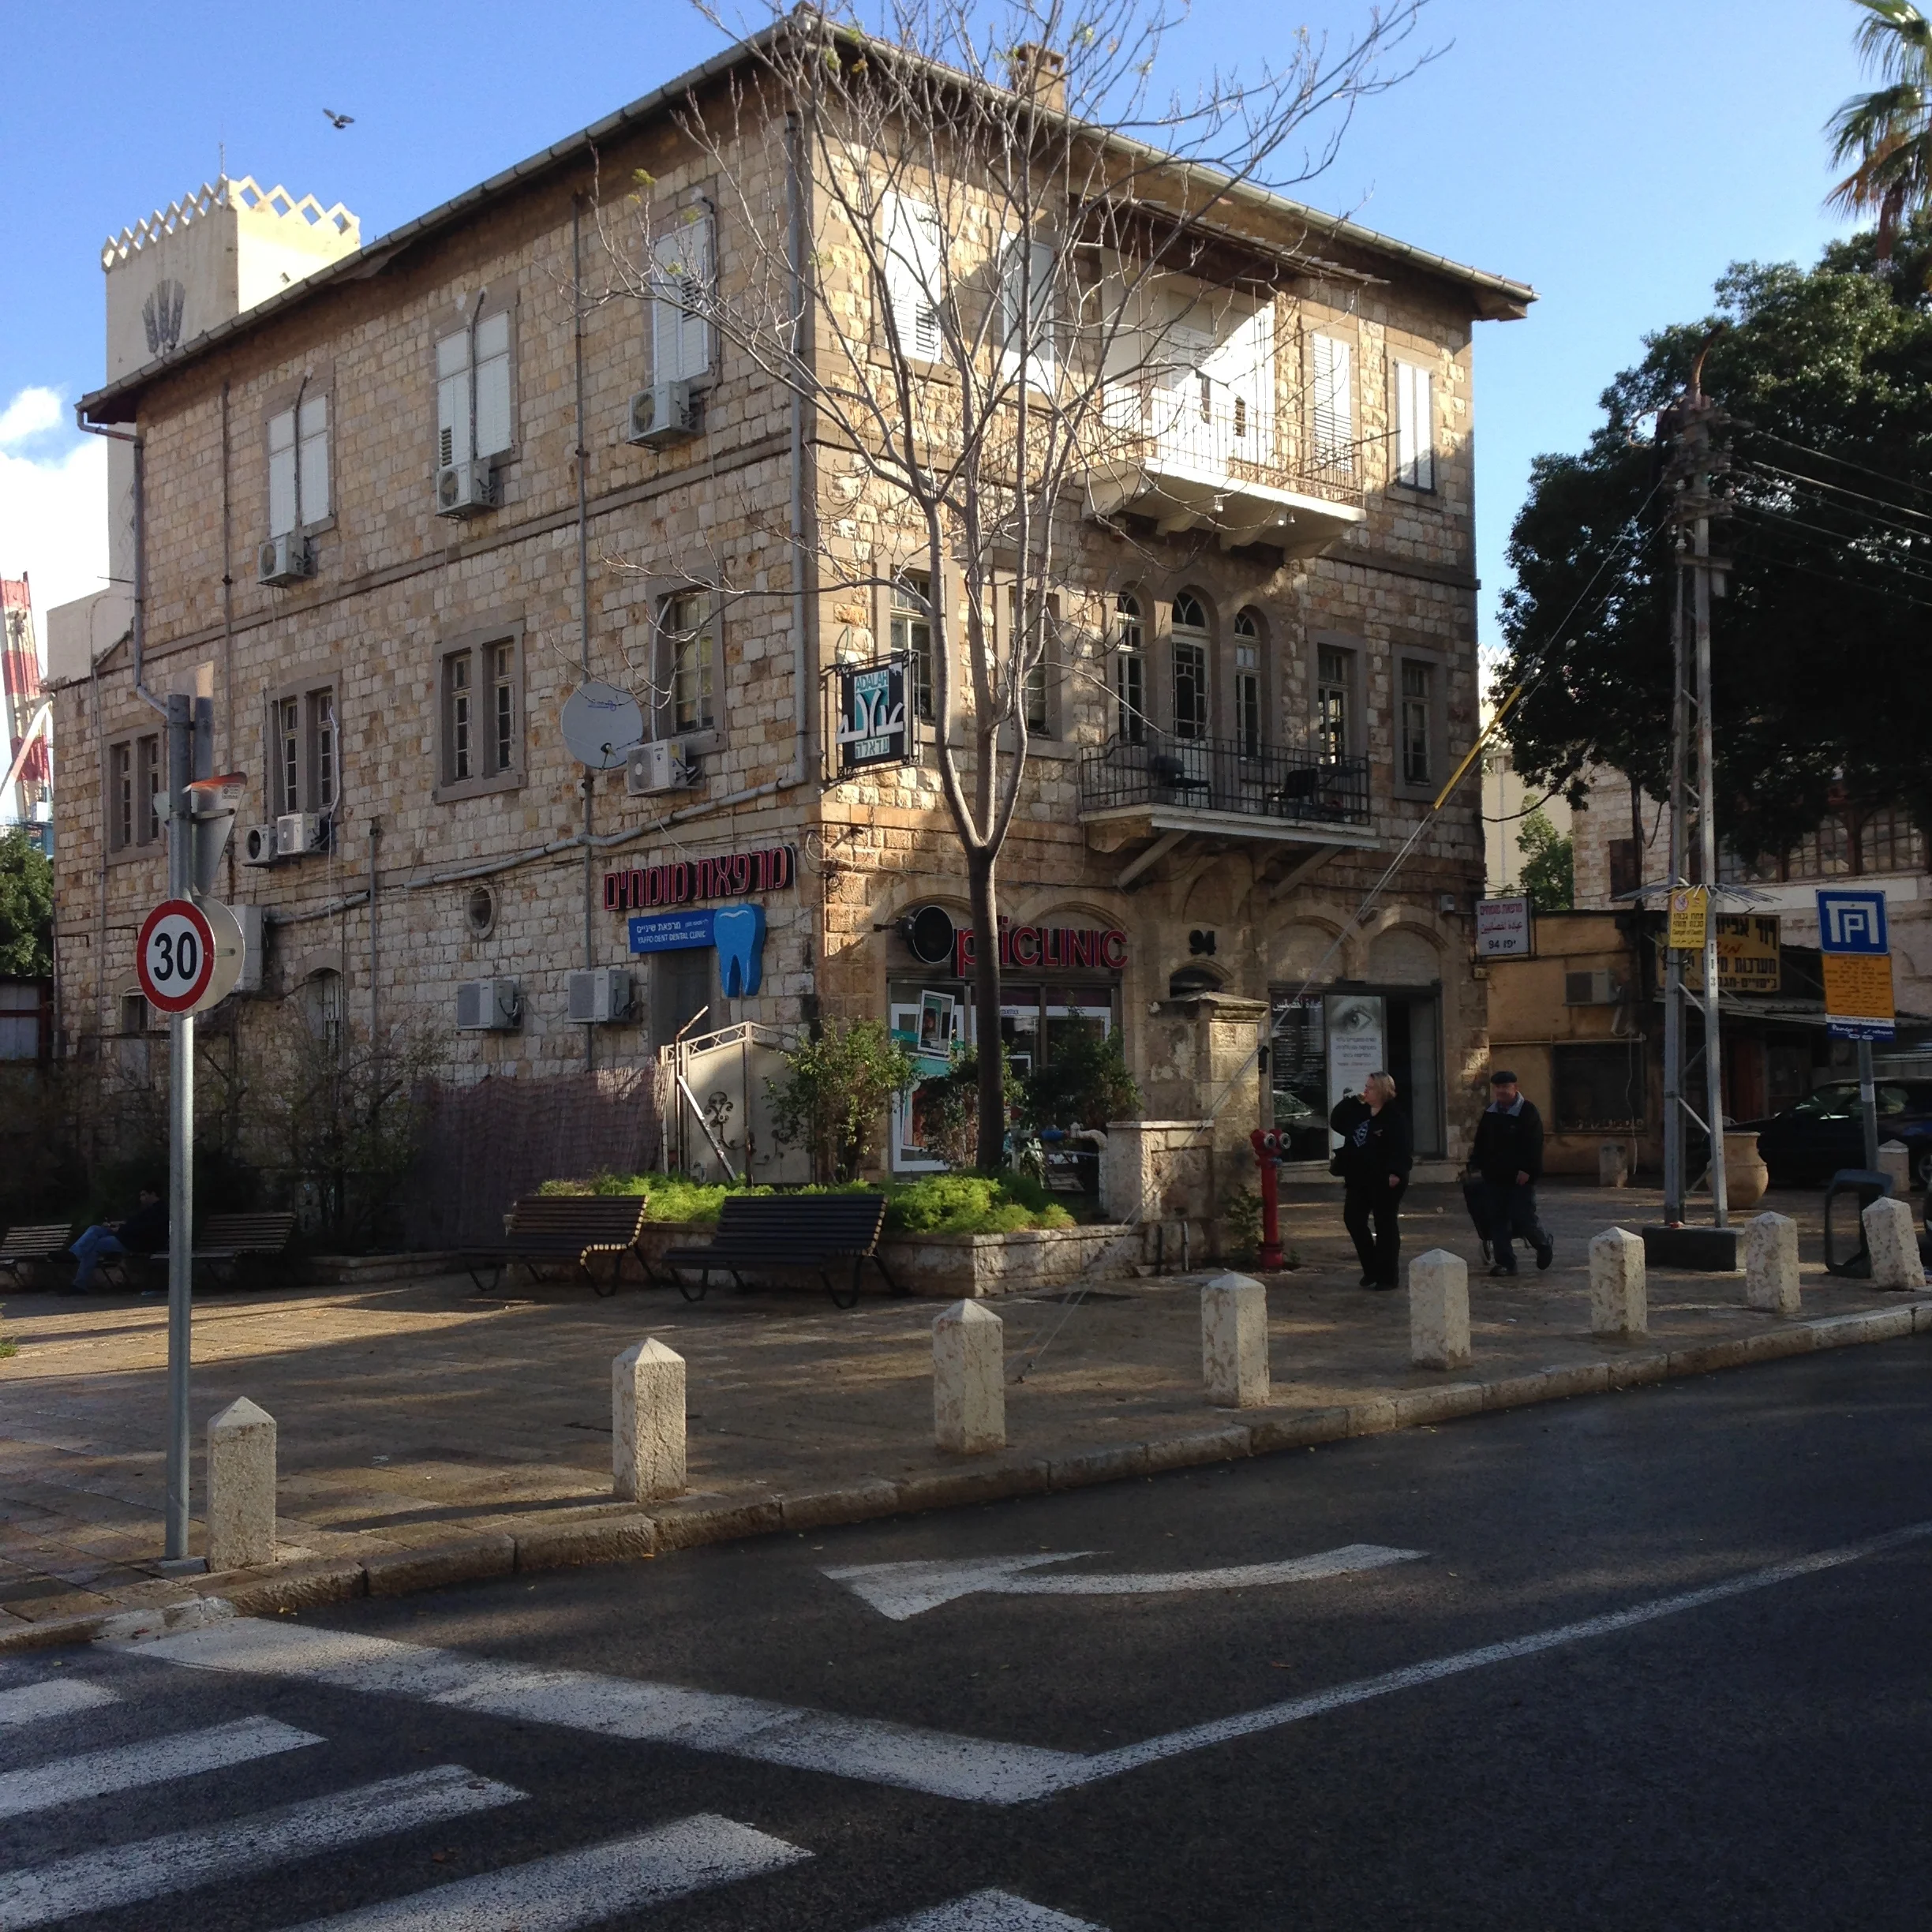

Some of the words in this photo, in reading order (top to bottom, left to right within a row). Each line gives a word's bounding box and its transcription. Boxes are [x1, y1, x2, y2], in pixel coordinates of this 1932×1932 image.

[856, 672, 889, 691] ADALAH
[856, 738, 889, 758] עדאלה
[695, 846, 788, 900] מרפאת
[604, 861, 689, 912] מומחים
[636, 923, 656, 934] שיניים
[657, 921, 681, 931] מרפאת
[668, 932, 688, 942] DENTAL
[689, 930, 706, 939] CLINIC
[1488, 939, 1500, 949] 94
[1503, 939, 1517, 949] יפו
[153, 931, 197, 981] 30
